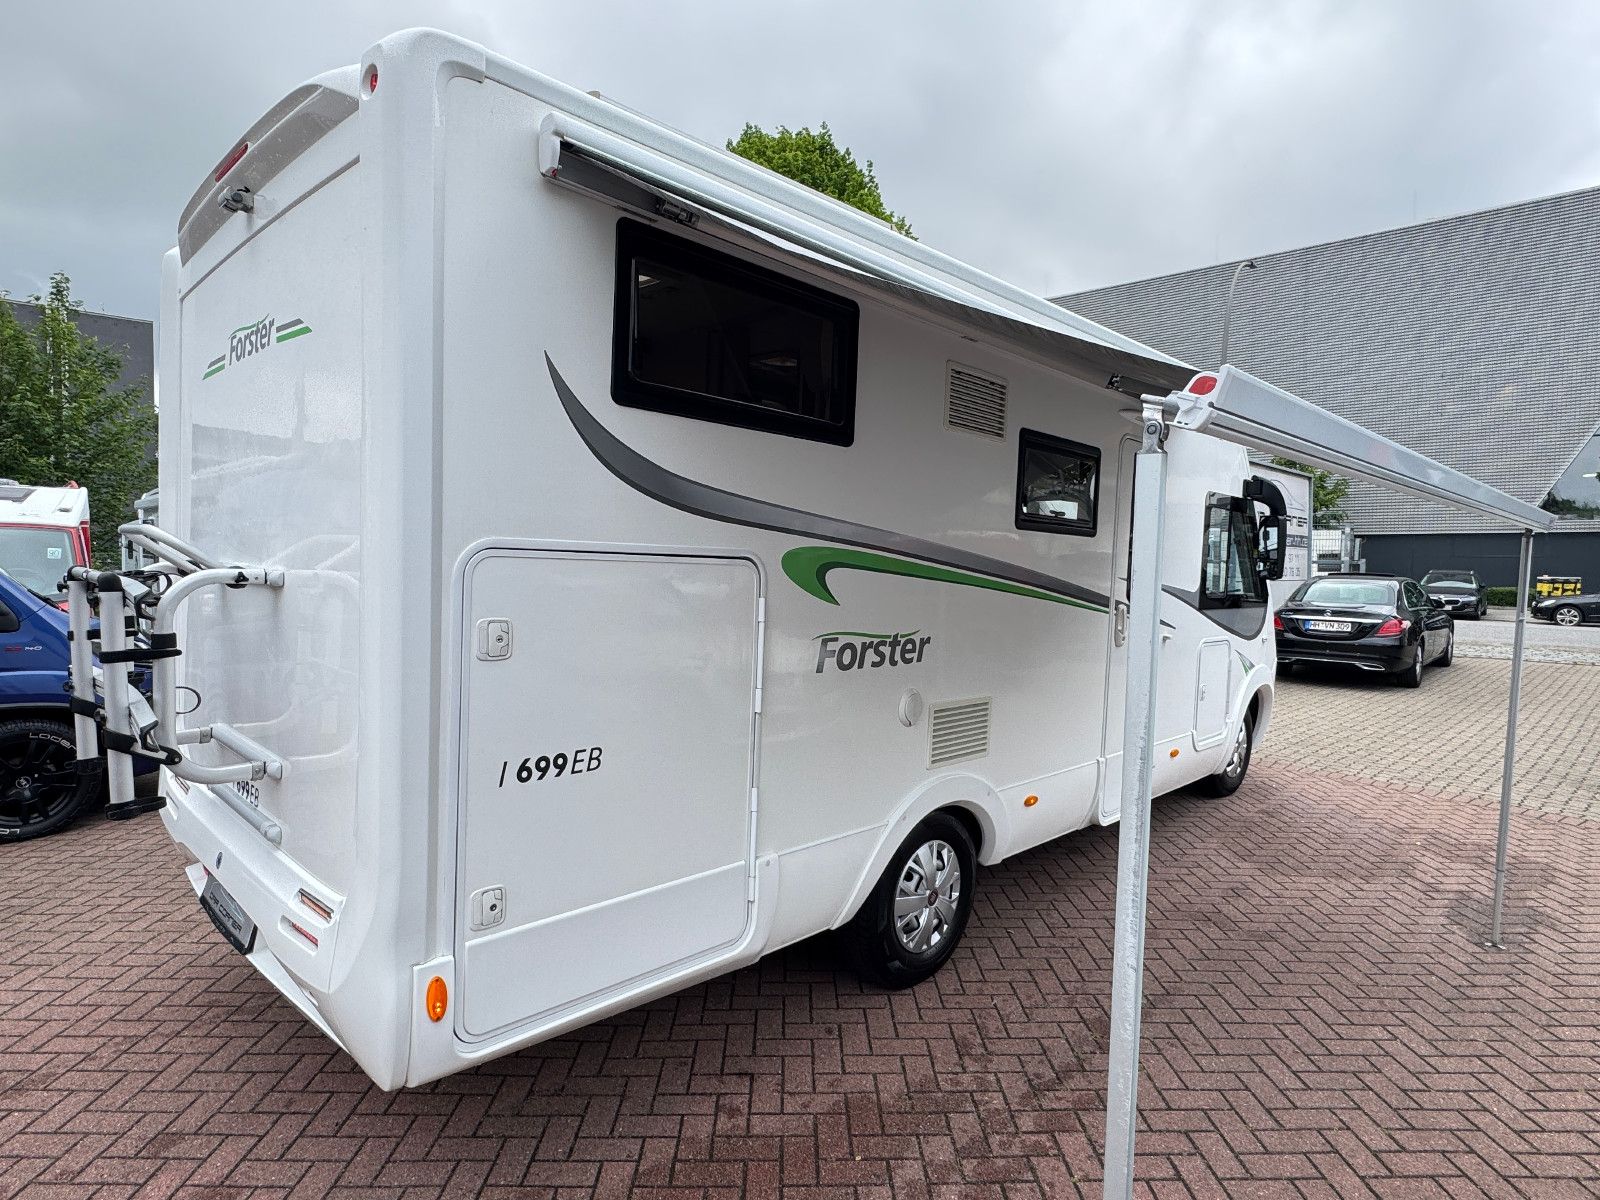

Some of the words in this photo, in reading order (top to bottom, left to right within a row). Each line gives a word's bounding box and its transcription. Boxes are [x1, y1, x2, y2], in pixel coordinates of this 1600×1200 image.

[228, 317, 275, 366] Forster
[1309, 620, 1320, 628] HH
[1336, 623, 1350, 631] 309
[815, 632, 932, 674] Forster
[516, 747, 603, 784] 699EB
